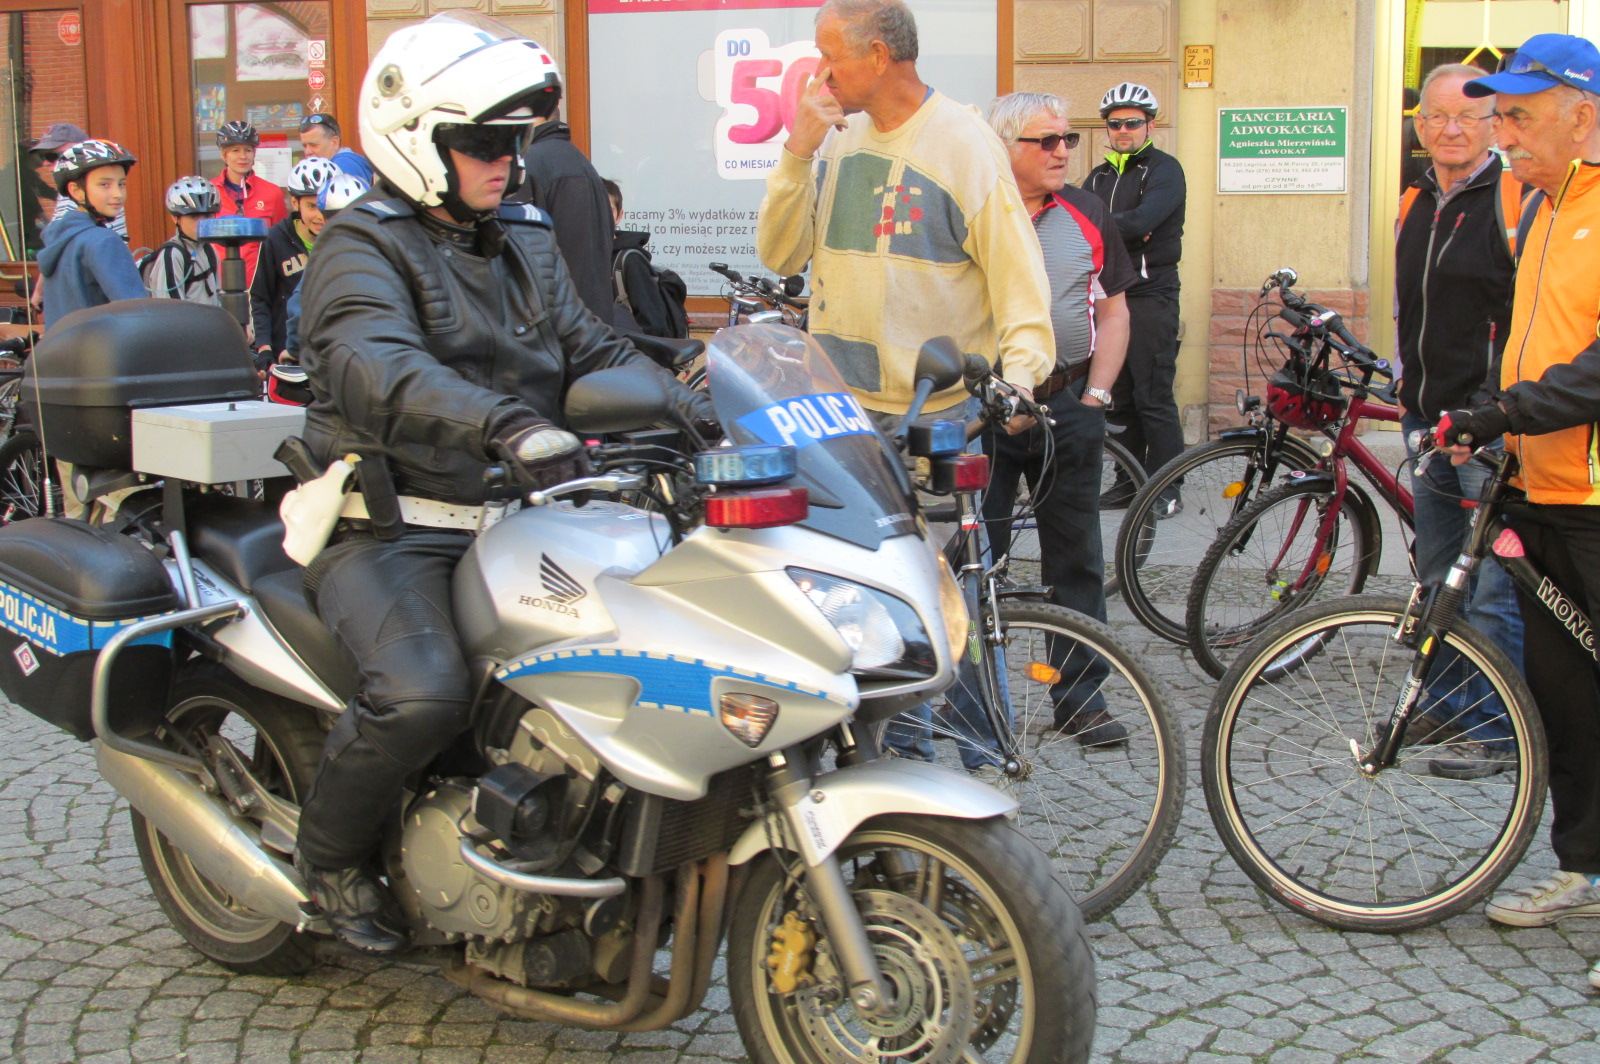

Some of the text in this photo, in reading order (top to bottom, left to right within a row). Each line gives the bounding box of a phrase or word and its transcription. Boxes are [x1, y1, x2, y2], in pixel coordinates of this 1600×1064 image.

[727, 40, 751, 57] DO
[1188, 55, 1196, 66] Z
[1231, 112, 1336, 122] KANCELARIA
[1230, 124, 1336, 135] ADWOKACKA
[1229, 140, 1275, 148] Agnieszka
[725, 160, 738, 169] CO
[624, 211, 664, 222] racamy
[668, 208, 686, 220] 3%
[689, 208, 746, 222] wydatków
[624, 222, 638, 232] 50
[654, 226, 666, 234] co
[670, 223, 712, 237] miesiąc
[716, 226, 748, 237] przez
[662, 245, 682, 256] czy
[684, 243, 727, 254] możesz
[730, 242, 758, 258] wzią
[518, 594, 580, 618] HONDA
[1537, 576, 1598, 661] MONG
